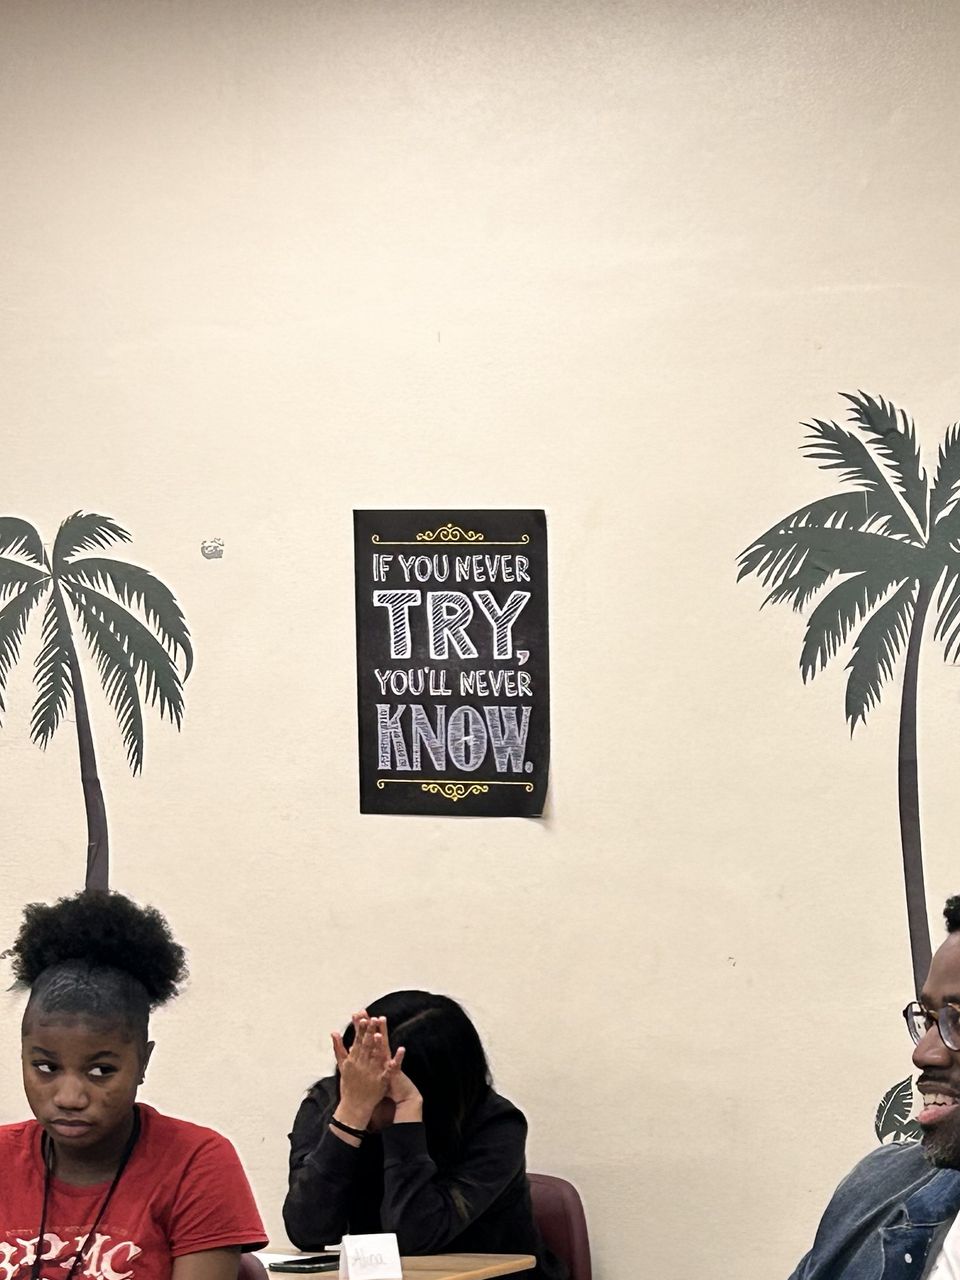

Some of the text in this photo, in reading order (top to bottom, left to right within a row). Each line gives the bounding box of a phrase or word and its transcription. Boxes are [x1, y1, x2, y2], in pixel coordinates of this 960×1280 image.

[372, 553, 531, 583] IF YOU NEVER
[373, 589, 532, 666] TRY,
[374, 667, 533, 697] YOU'LL NEVER
[375, 703, 534, 774] KNOW.
